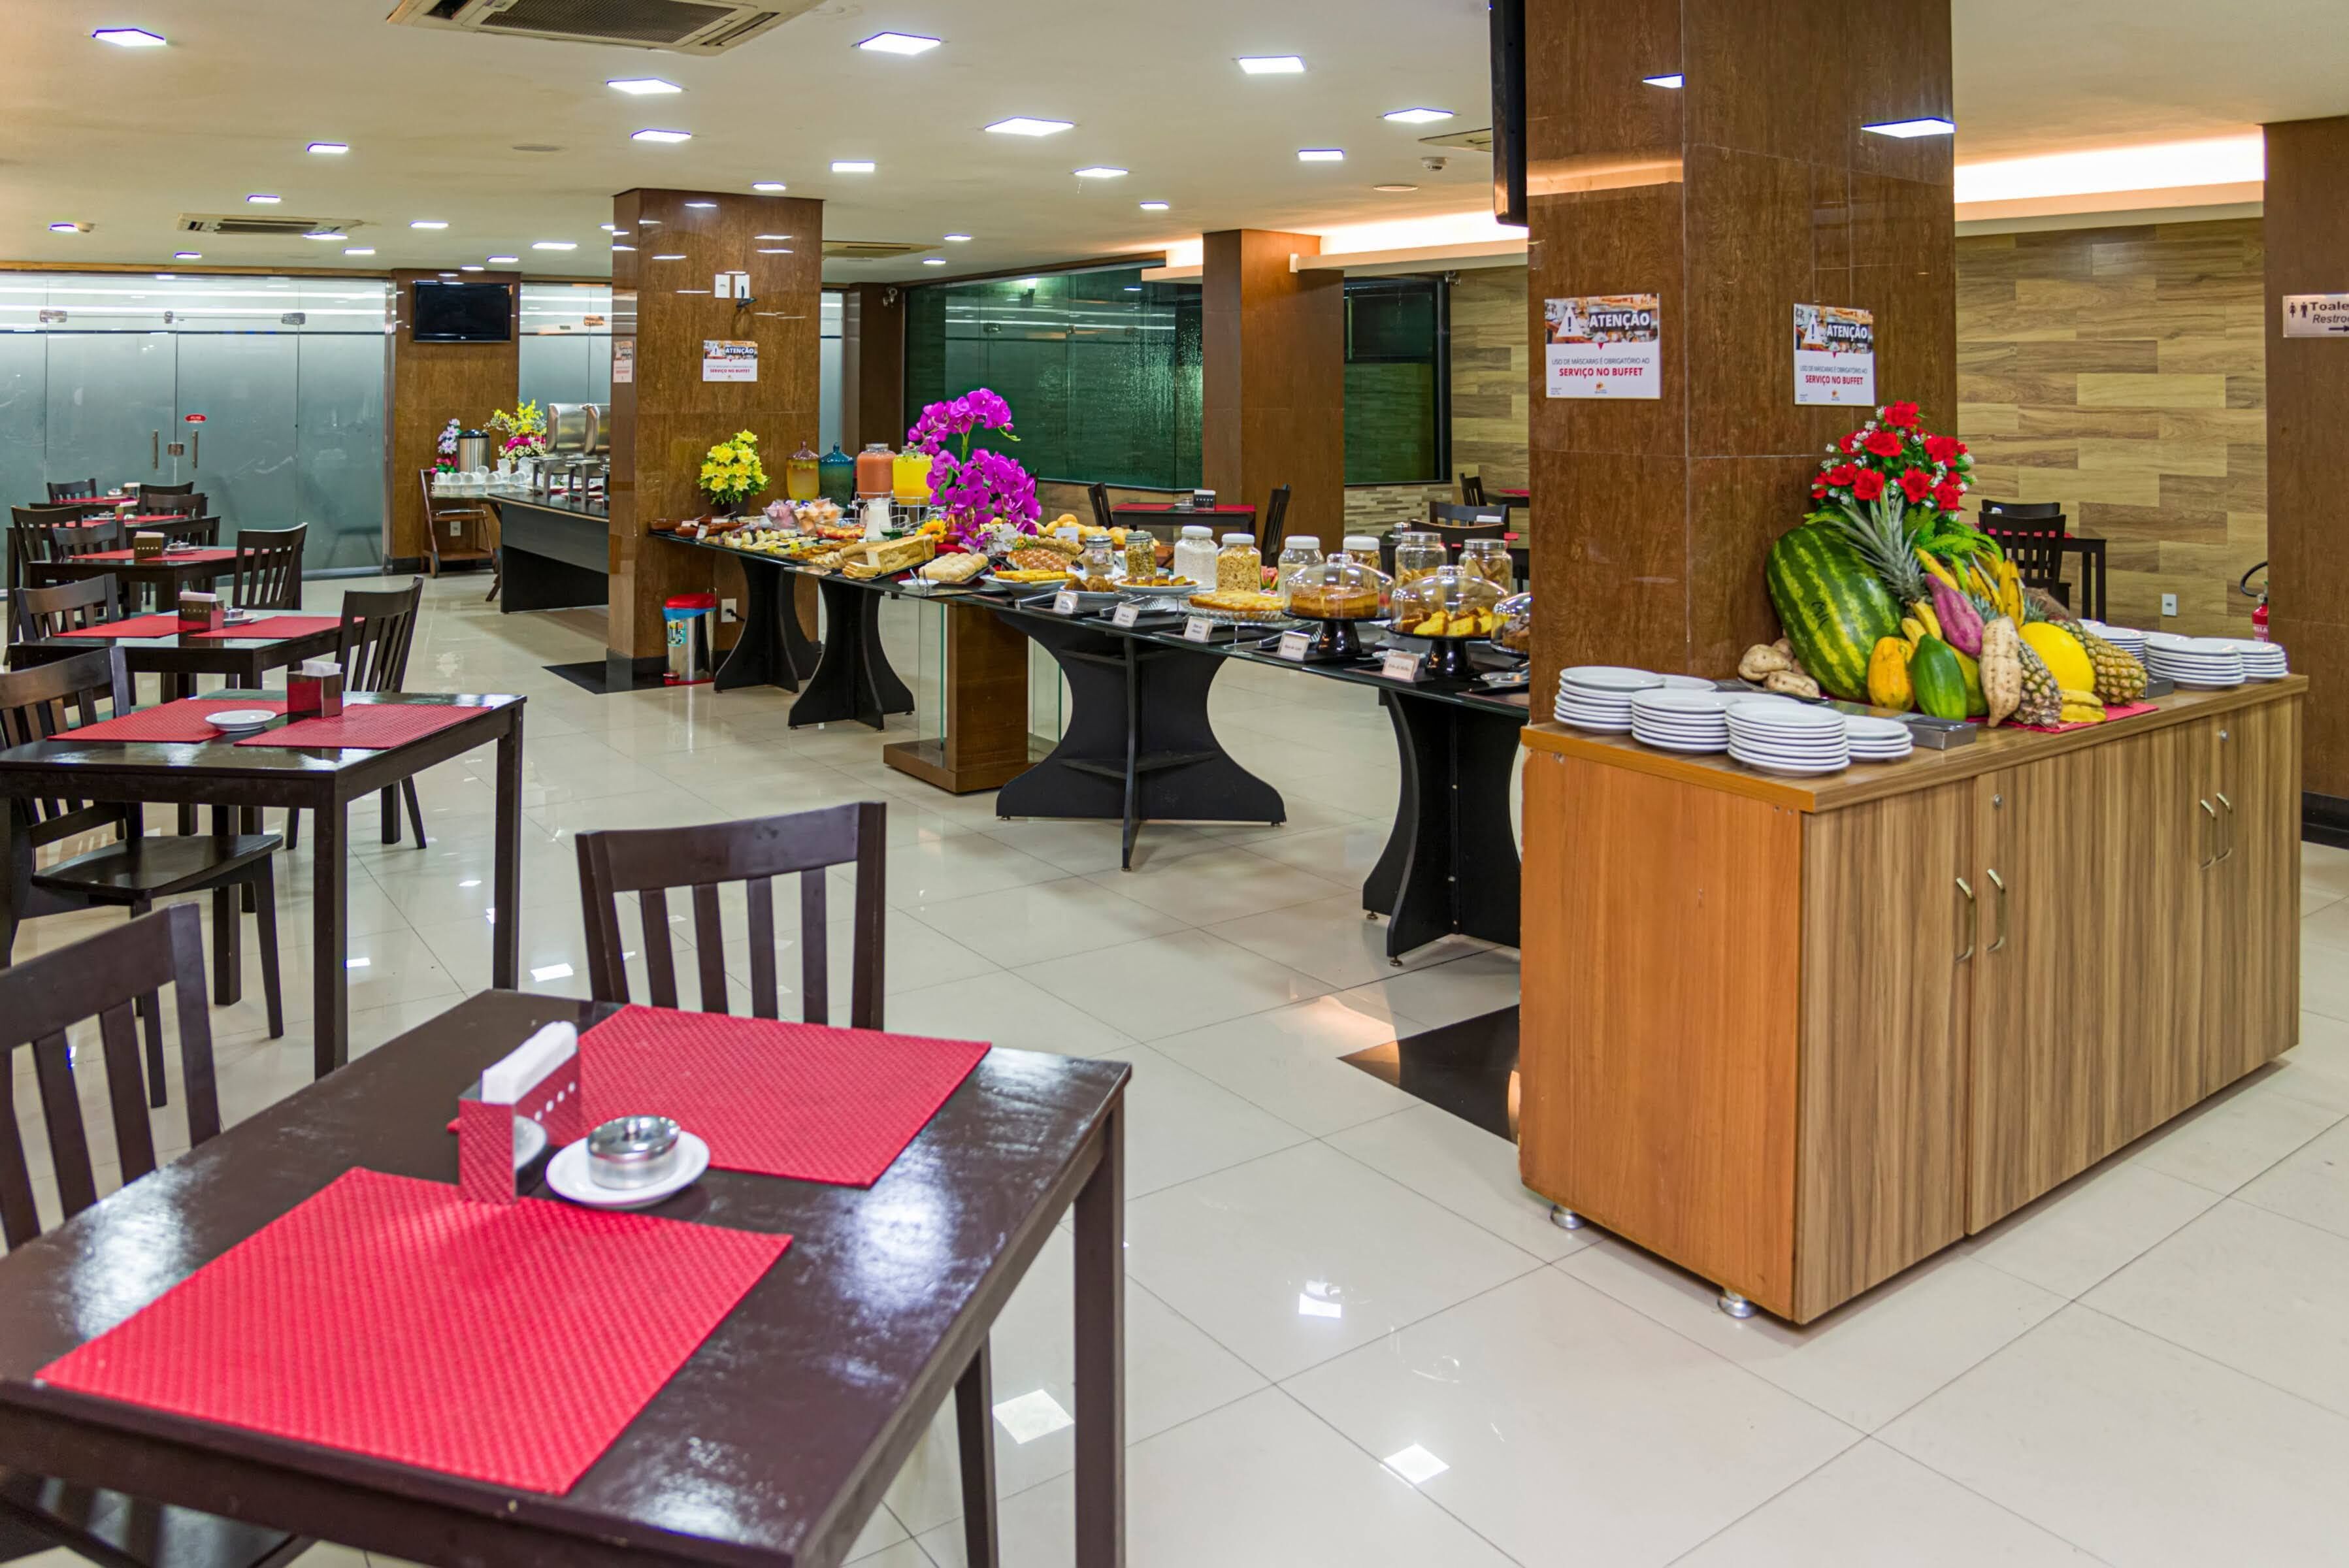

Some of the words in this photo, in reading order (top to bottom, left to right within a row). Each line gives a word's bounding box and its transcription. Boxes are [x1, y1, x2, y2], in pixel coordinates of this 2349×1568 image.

[1589, 310, 1650, 329] ATENÇÃO
[2312, 314, 2349, 323] Restro
[1827, 323, 1867, 341] ATENÇÃO
[1559, 368, 1594, 378] SERVIÇO
[1596, 368, 1609, 376] NO
[1613, 367, 1643, 376] BUFFET
[1805, 375, 1830, 385] SERVIÇO
[1832, 376, 1841, 384] NO
[1843, 376, 1864, 385] BUFFET
